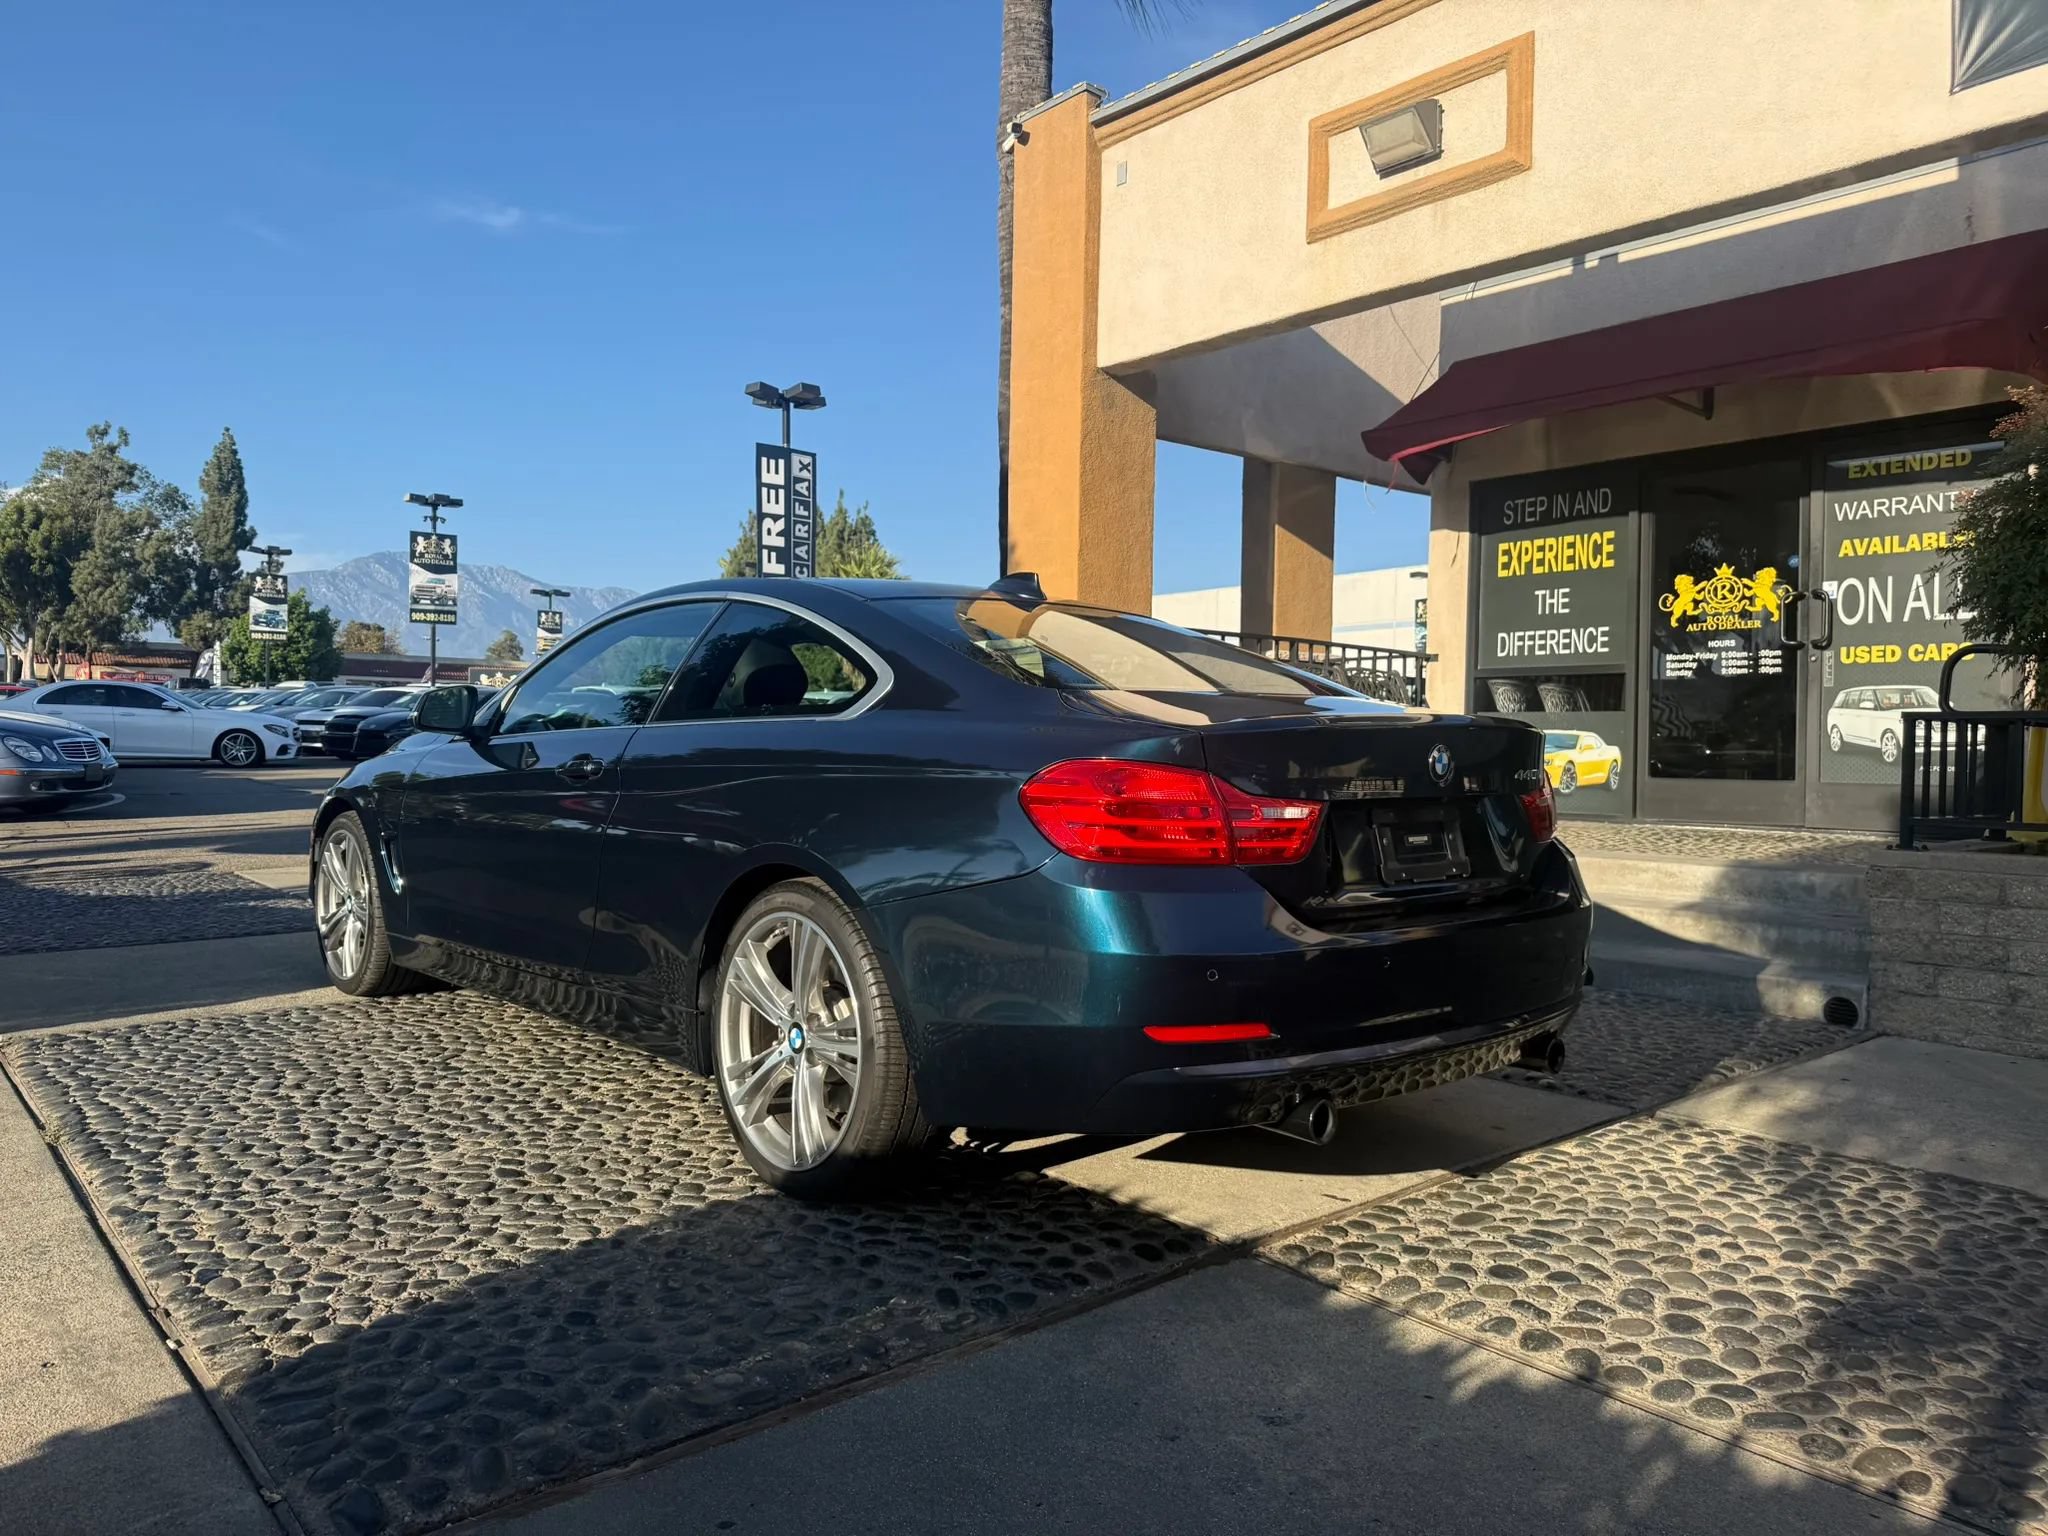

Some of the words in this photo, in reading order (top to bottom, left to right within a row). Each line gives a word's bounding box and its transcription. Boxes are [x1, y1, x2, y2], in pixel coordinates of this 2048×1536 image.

[1848, 449, 1972, 479] EXTENDED
[761, 456, 785, 575] FREE
[795, 458, 811, 578] CARFAX
[1503, 496, 1547, 525] STEP
[1552, 493, 1569, 518] IN
[1573, 488, 1612, 516] AND
[1834, 491, 1961, 522] WARRANT
[1498, 530, 1615, 578] EXPERIENCE
[1534, 587, 1570, 616] THE
[1836, 575, 1893, 626] ON
[1686, 622, 1717, 632] AUTO
[1718, 620, 1762, 630] DEALER
[1706, 614, 1741, 624] ROYAL
[1497, 626, 1609, 657] DIFFERENCE
[1708, 640, 1736, 648] HOURS
[1840, 644, 1902, 665] USED
[1666, 652, 1718, 661] Monday-Friday
[1666, 661, 1698, 669] Saturday
[1666, 669, 1693, 678] Sunday
